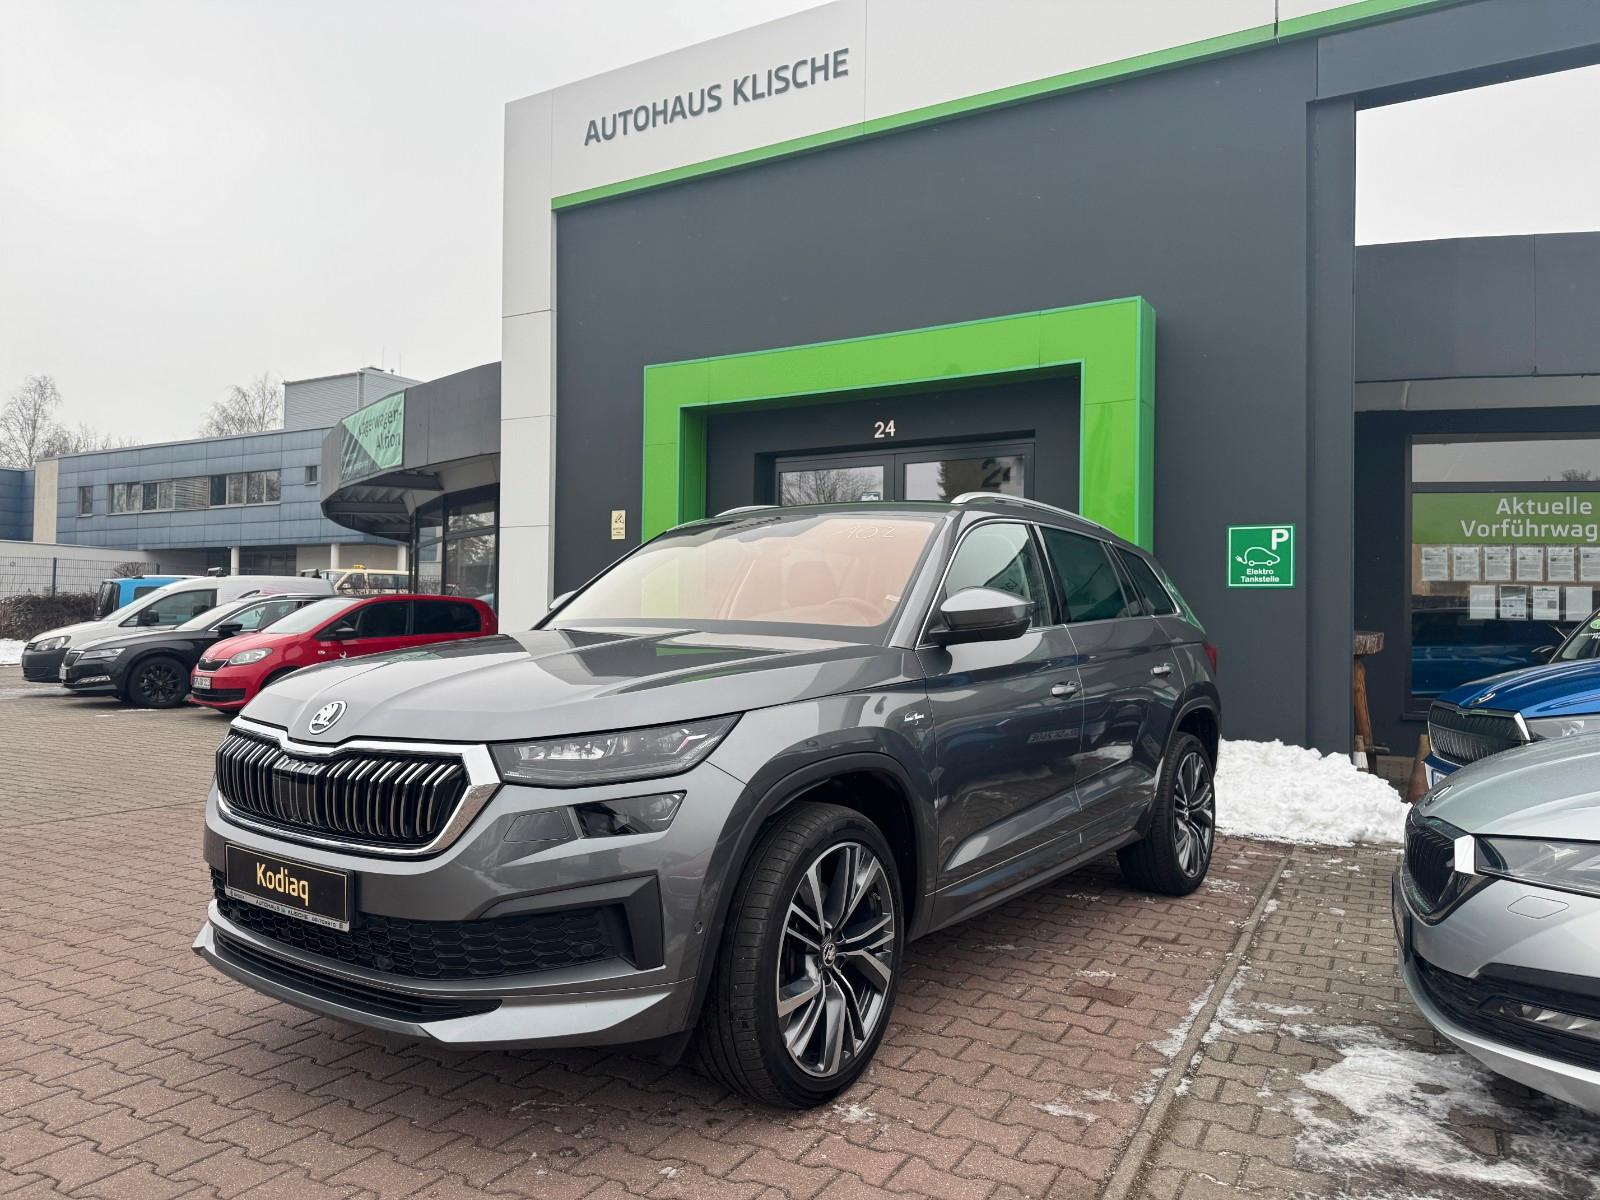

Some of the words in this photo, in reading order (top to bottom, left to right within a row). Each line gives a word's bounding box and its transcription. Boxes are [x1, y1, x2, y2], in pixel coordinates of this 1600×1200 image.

[584, 84, 722, 147] AUTOHAUS
[733, 48, 849, 106] KLISCHE
[874, 420, 896, 438] 24
[1496, 496, 1593, 515] Aktuelle
[1271, 528, 1290, 551] P
[1460, 518, 1598, 542] Vorführwag
[1240, 575, 1280, 583] Tankstelle
[256, 862, 309, 907] Kodiaq
